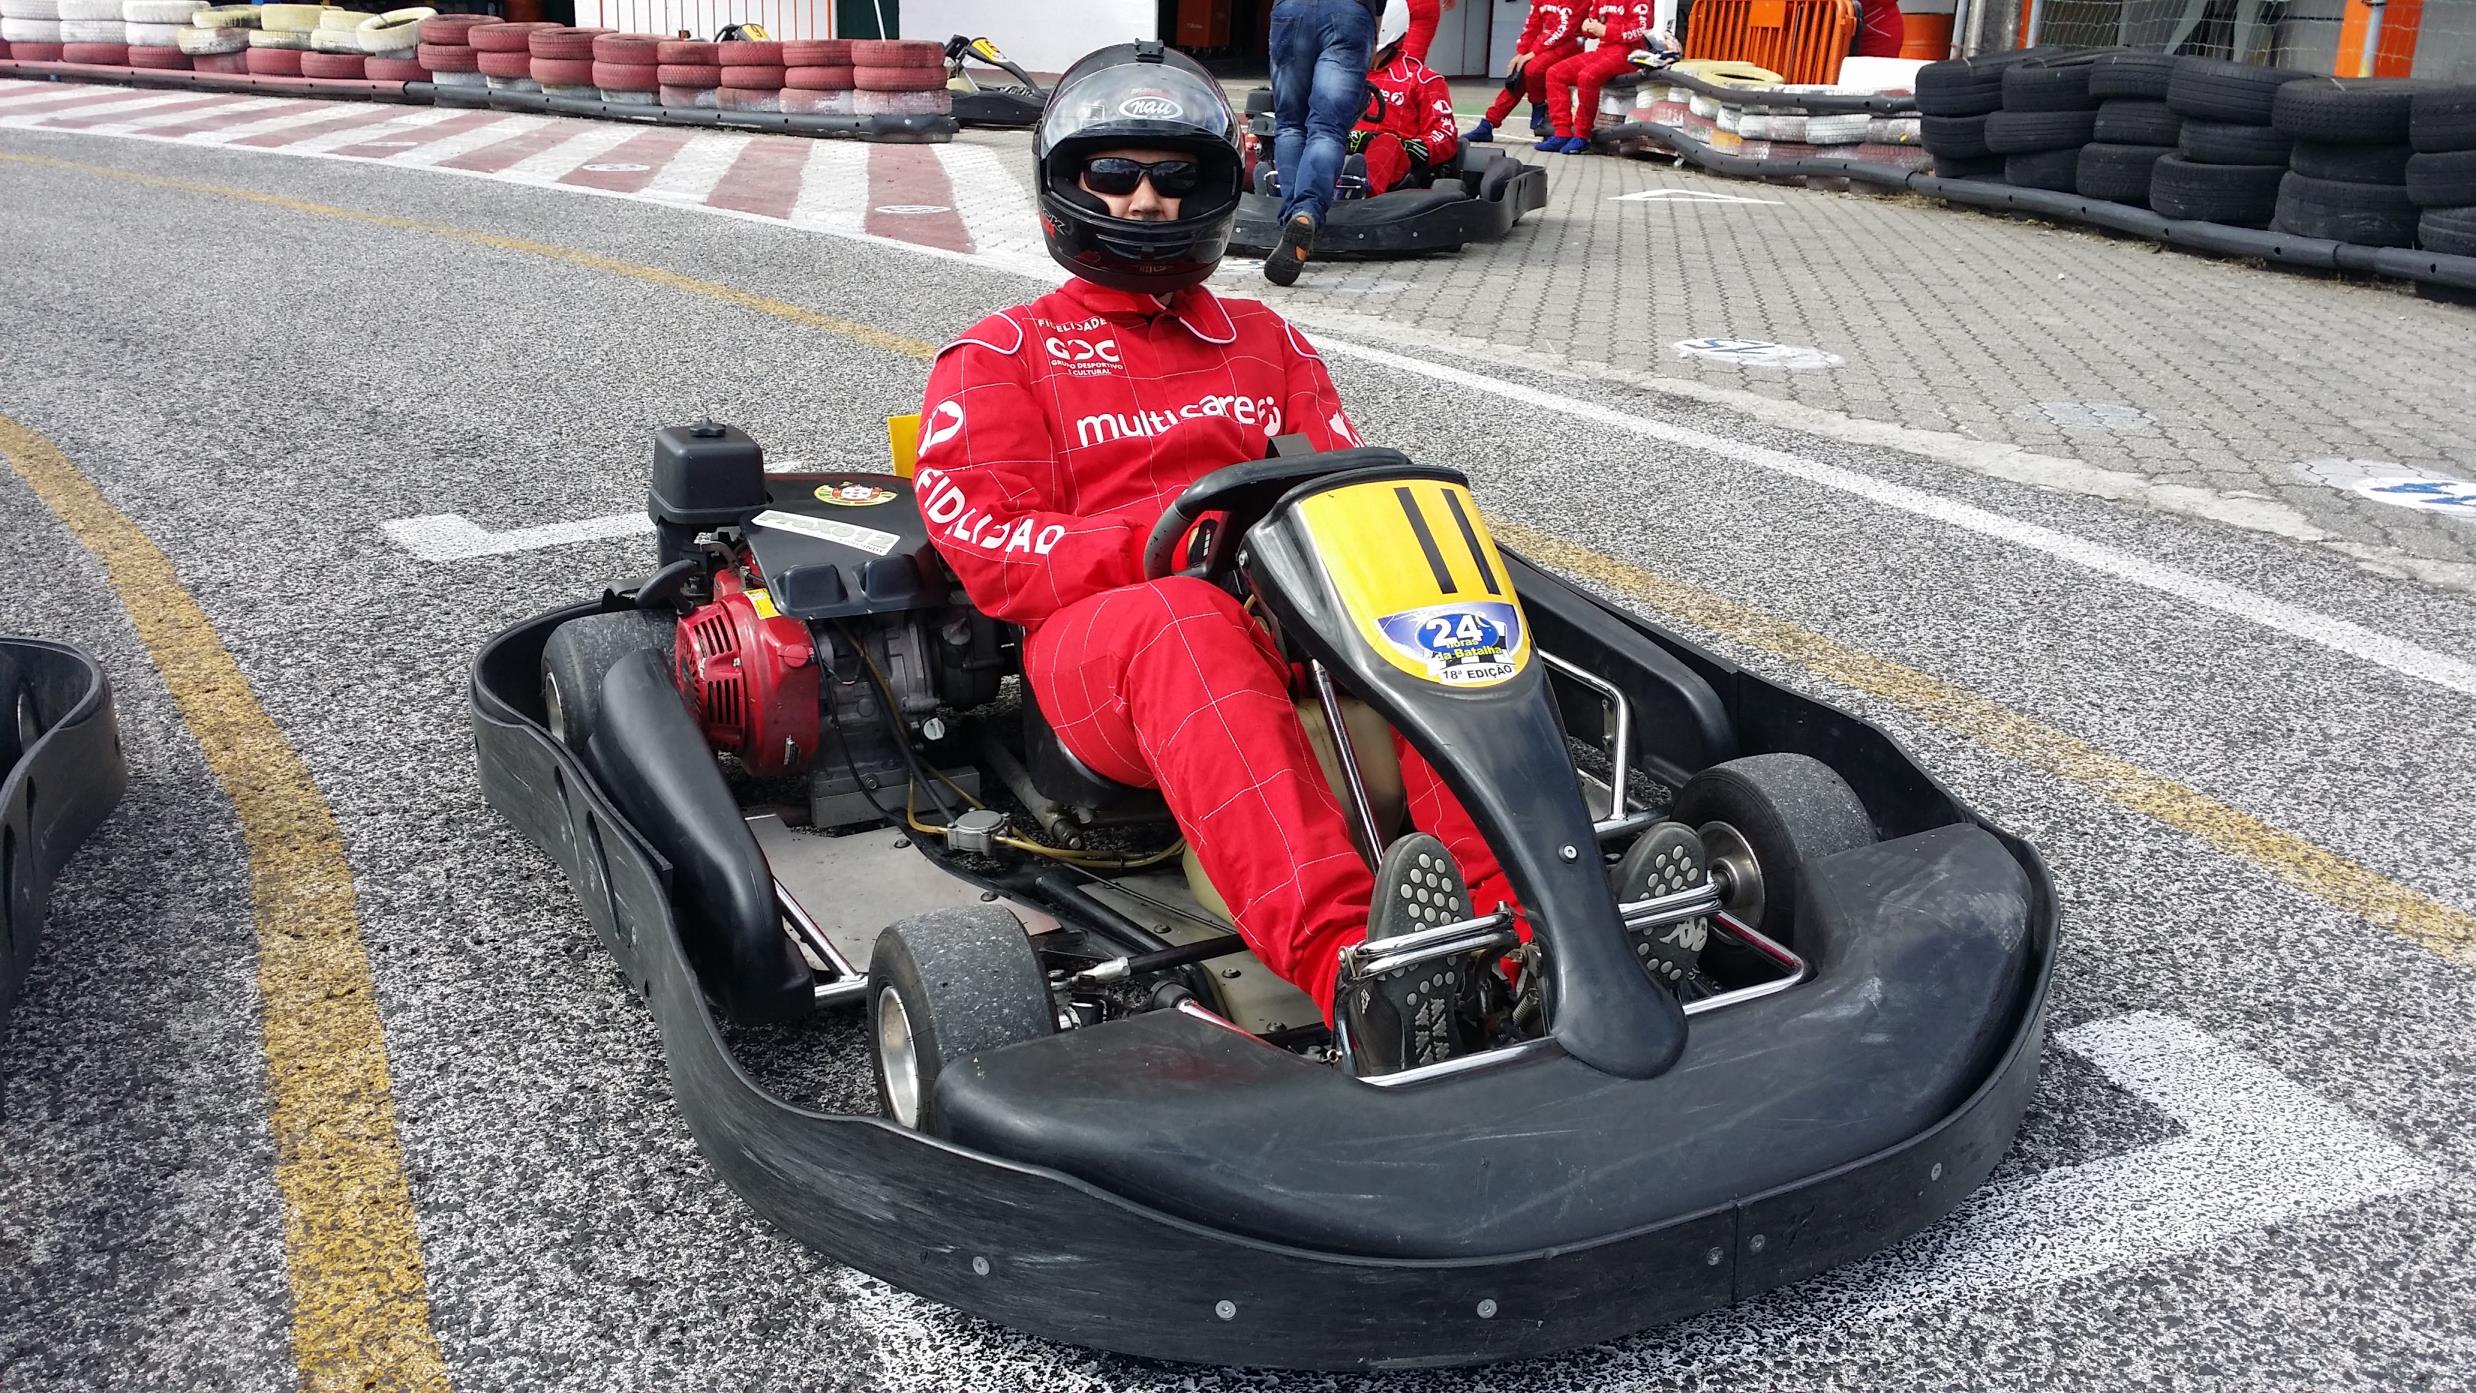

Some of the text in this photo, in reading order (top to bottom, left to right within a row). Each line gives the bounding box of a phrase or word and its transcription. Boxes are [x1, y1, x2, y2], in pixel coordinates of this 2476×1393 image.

[1045, 336, 1120, 363] GDC
[1072, 368, 1112, 377] CULTURAL
[1076, 361, 1124, 371] DESPORTIVO
[1076, 394, 1256, 448] multicare
[1393, 486, 1502, 596] 11
[1426, 614, 1484, 648] 24
[1436, 645, 1503, 662] da Batalha
[1467, 664, 1513, 681] EDIÇÃO
